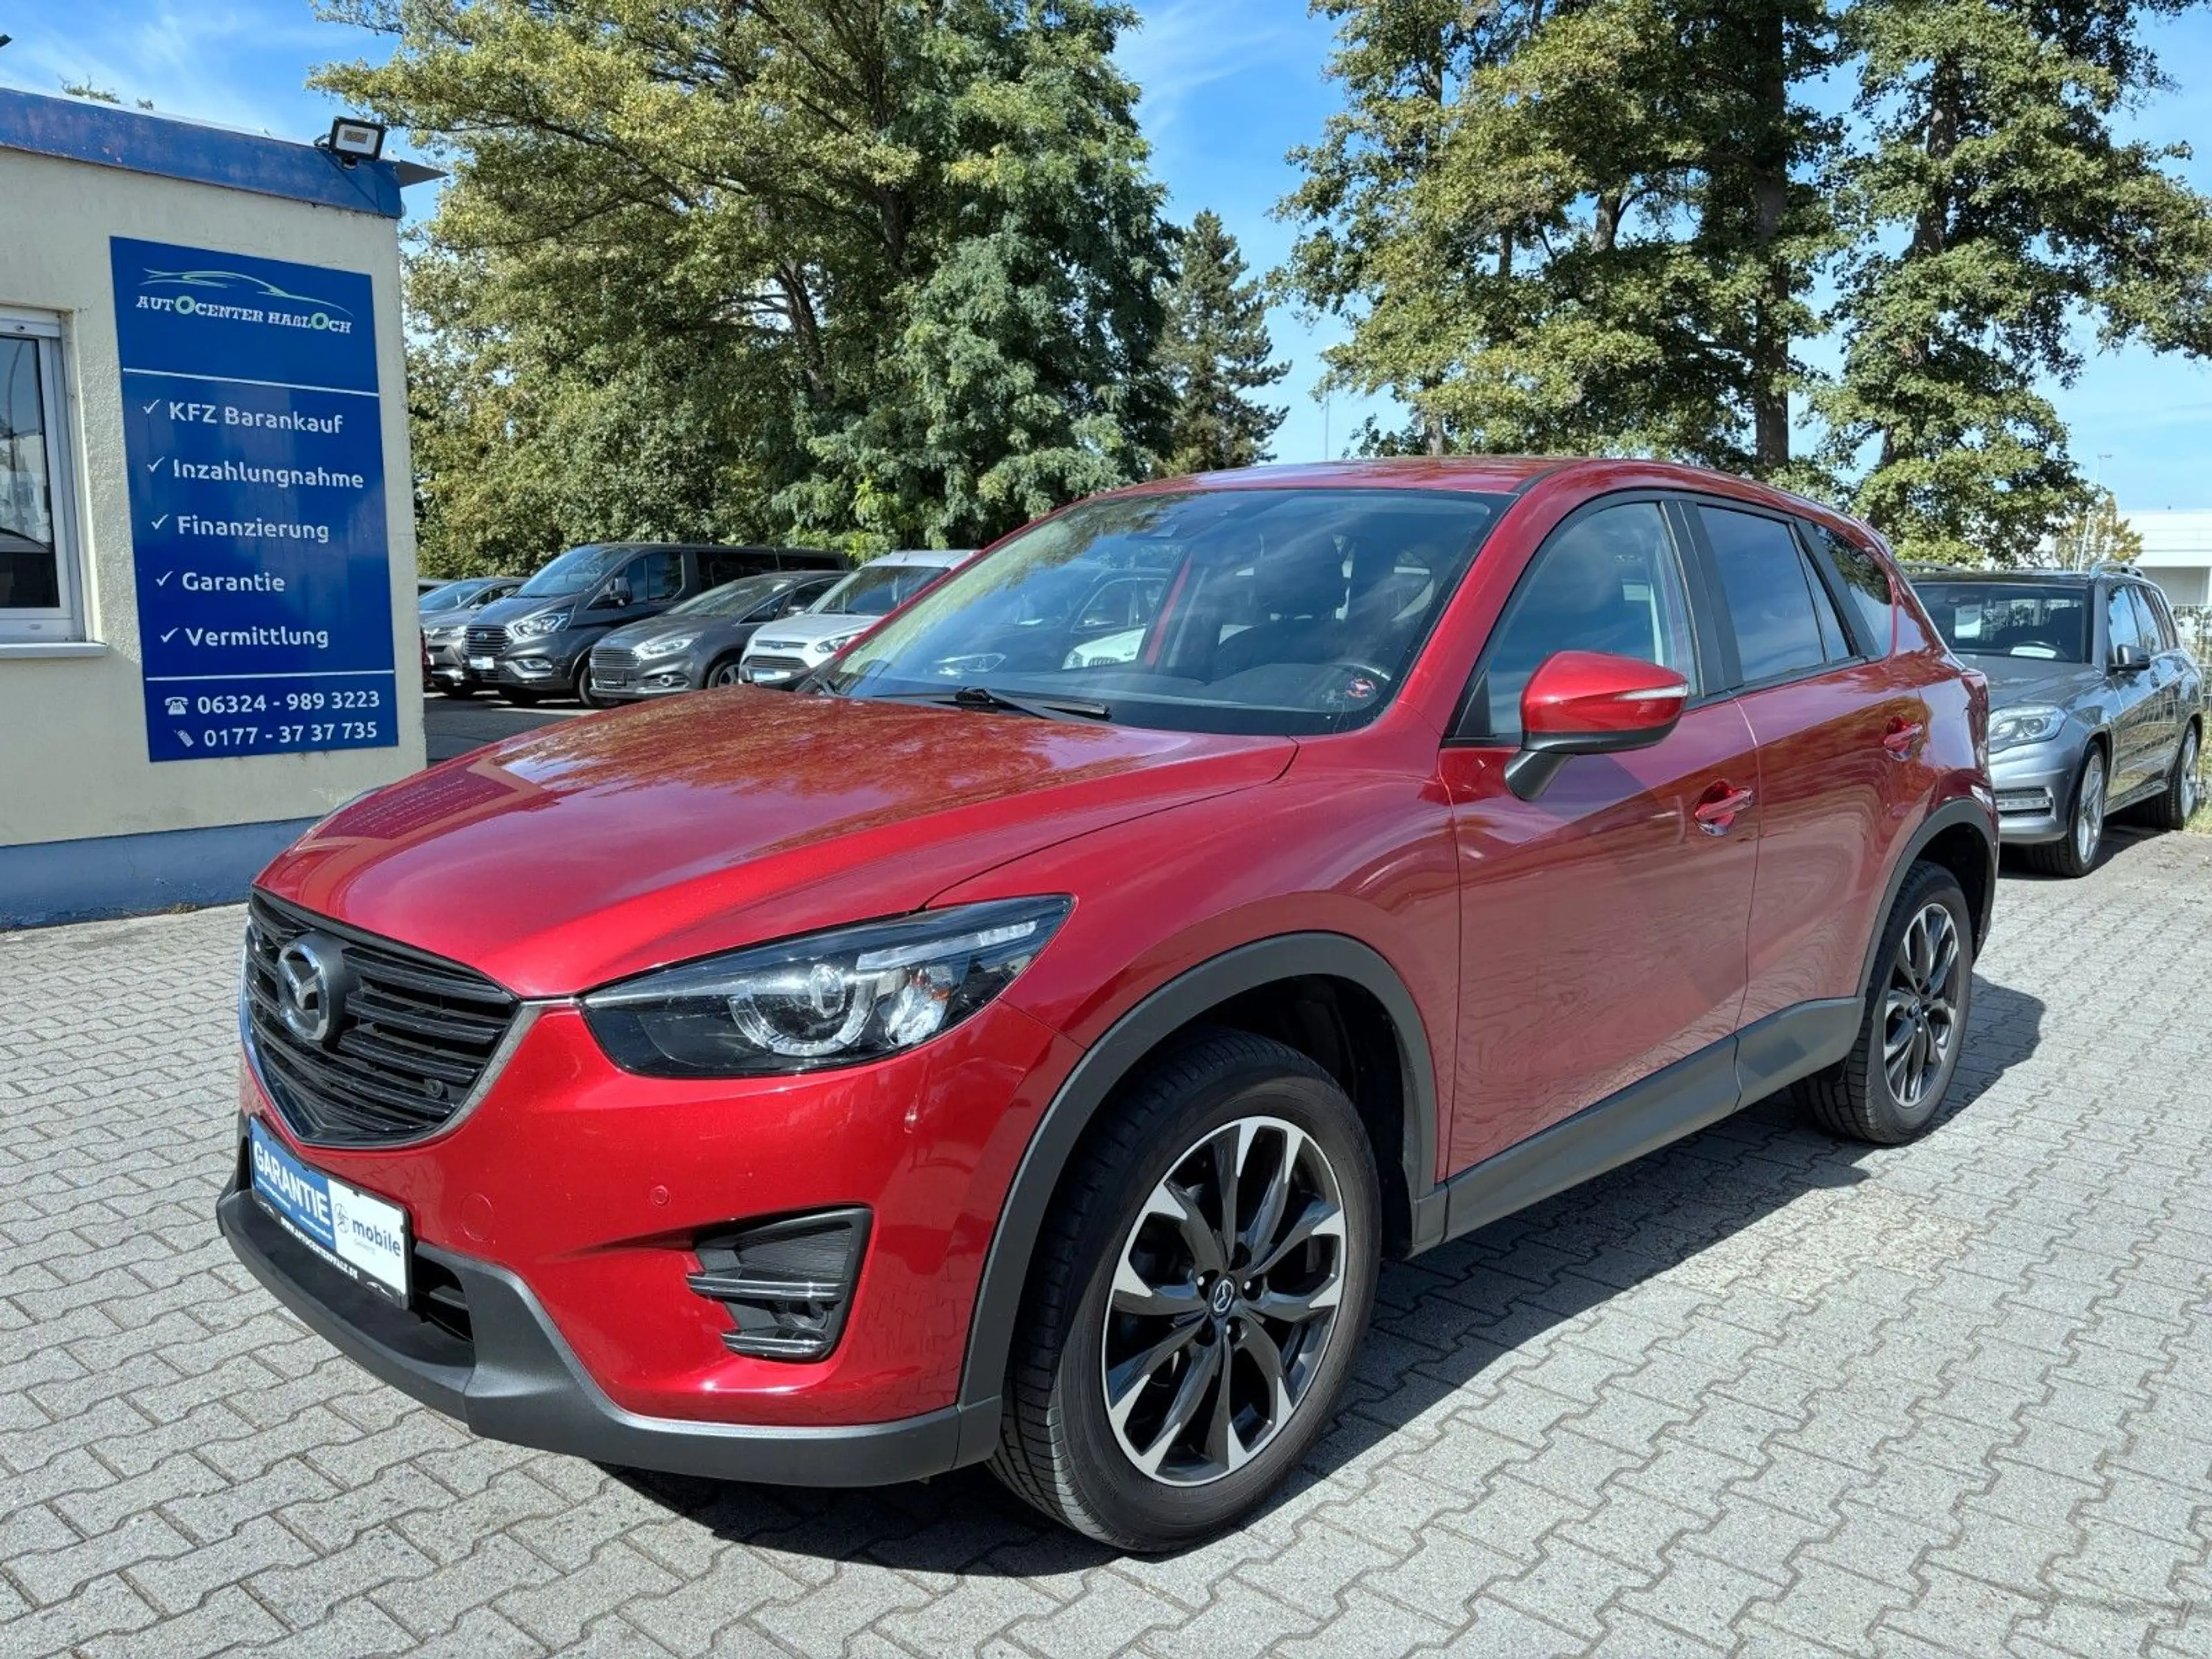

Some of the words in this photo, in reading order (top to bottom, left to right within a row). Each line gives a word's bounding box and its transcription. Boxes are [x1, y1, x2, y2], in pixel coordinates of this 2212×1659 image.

[136, 296, 263, 322] AUTOCENTER
[169, 402, 218, 423] KFZ
[224, 407, 343, 433] Barankauf
[173, 459, 363, 488] Inzahlungnahme
[177, 515, 329, 543] Finanzierung
[182, 572, 286, 591] Garantie
[185, 626, 328, 649] Vermittlung
[198, 695, 267, 714] 06324
[286, 693, 325, 710] 989
[331, 691, 380, 709] 3223
[204, 728, 258, 747] 0177
[279, 725, 304, 743] 37
[311, 724, 335, 741] 37
[341, 722, 377, 738] 735
[253, 1140, 332, 1226] GARANTIE
[351, 1218, 402, 1257] mobile
